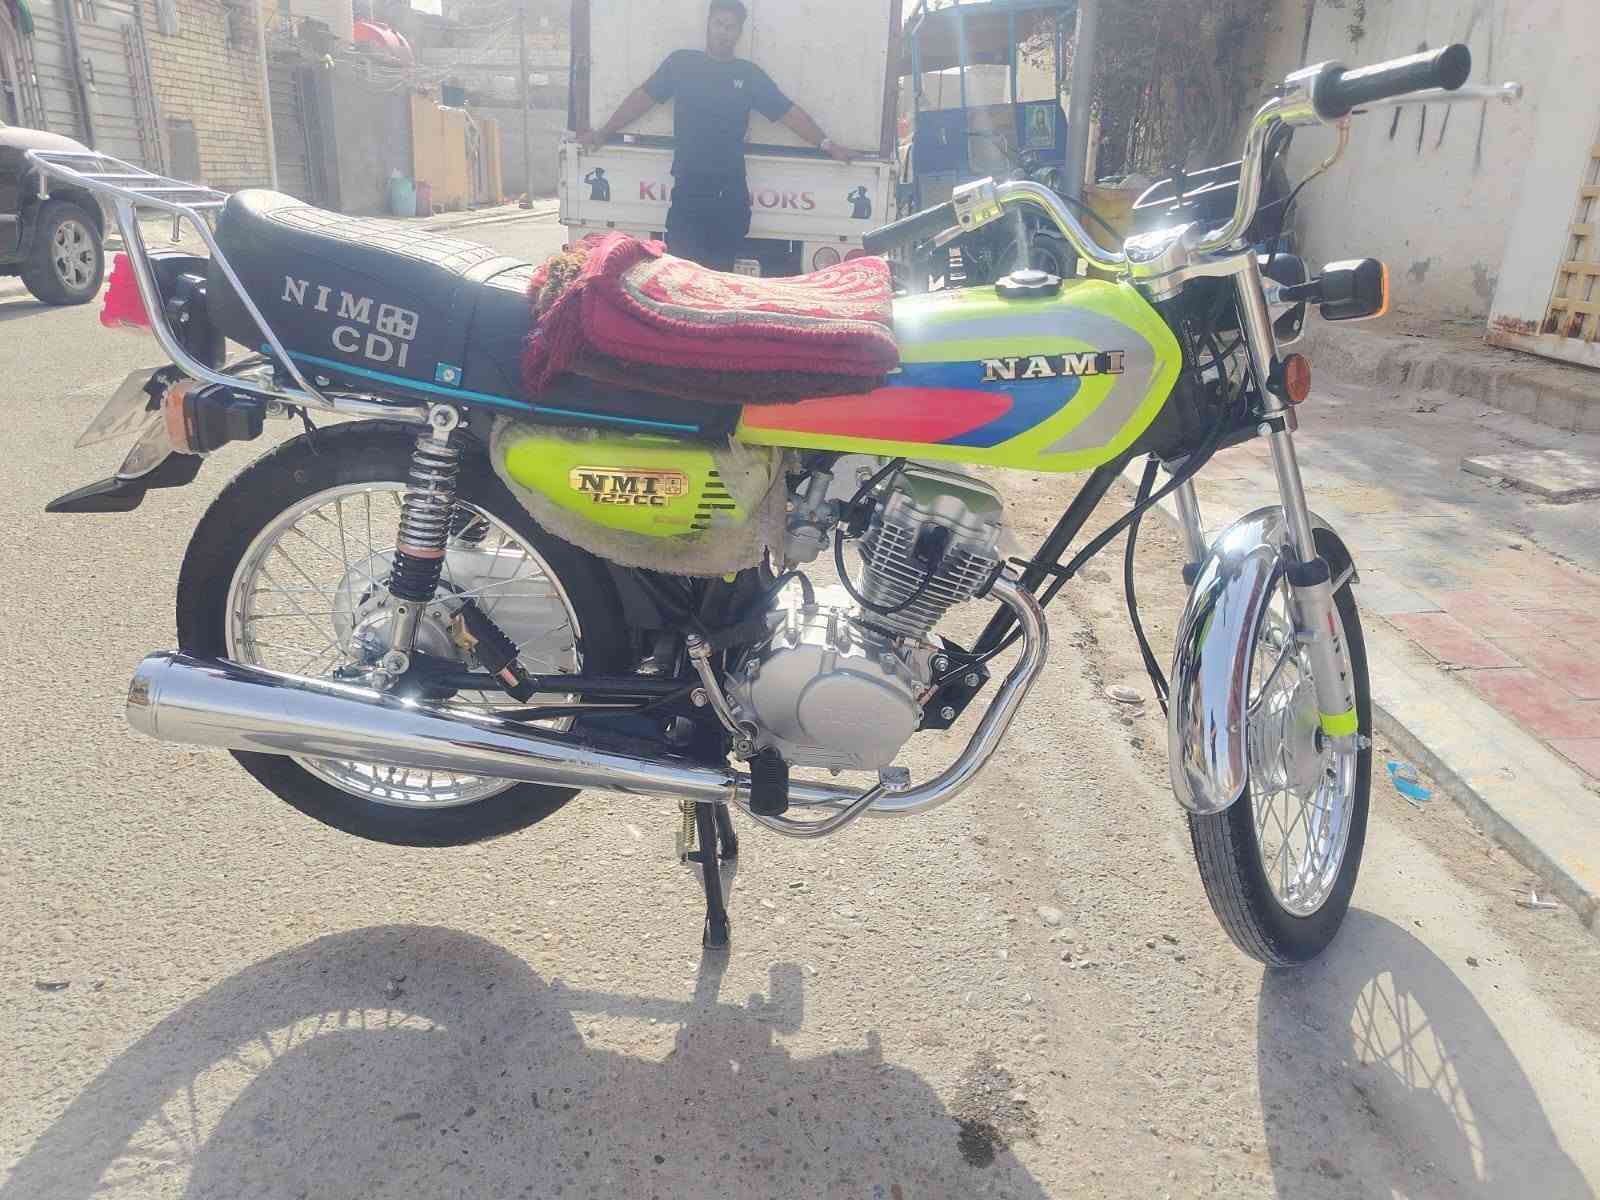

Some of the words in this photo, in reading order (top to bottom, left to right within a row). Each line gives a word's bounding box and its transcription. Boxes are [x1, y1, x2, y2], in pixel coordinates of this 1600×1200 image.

[640, 181, 672, 202] KI
[281, 275, 374, 325] NIM
[331, 325, 409, 368] CDI
[981, 350, 1125, 382] NAMI
[578, 473, 659, 494] NMI
